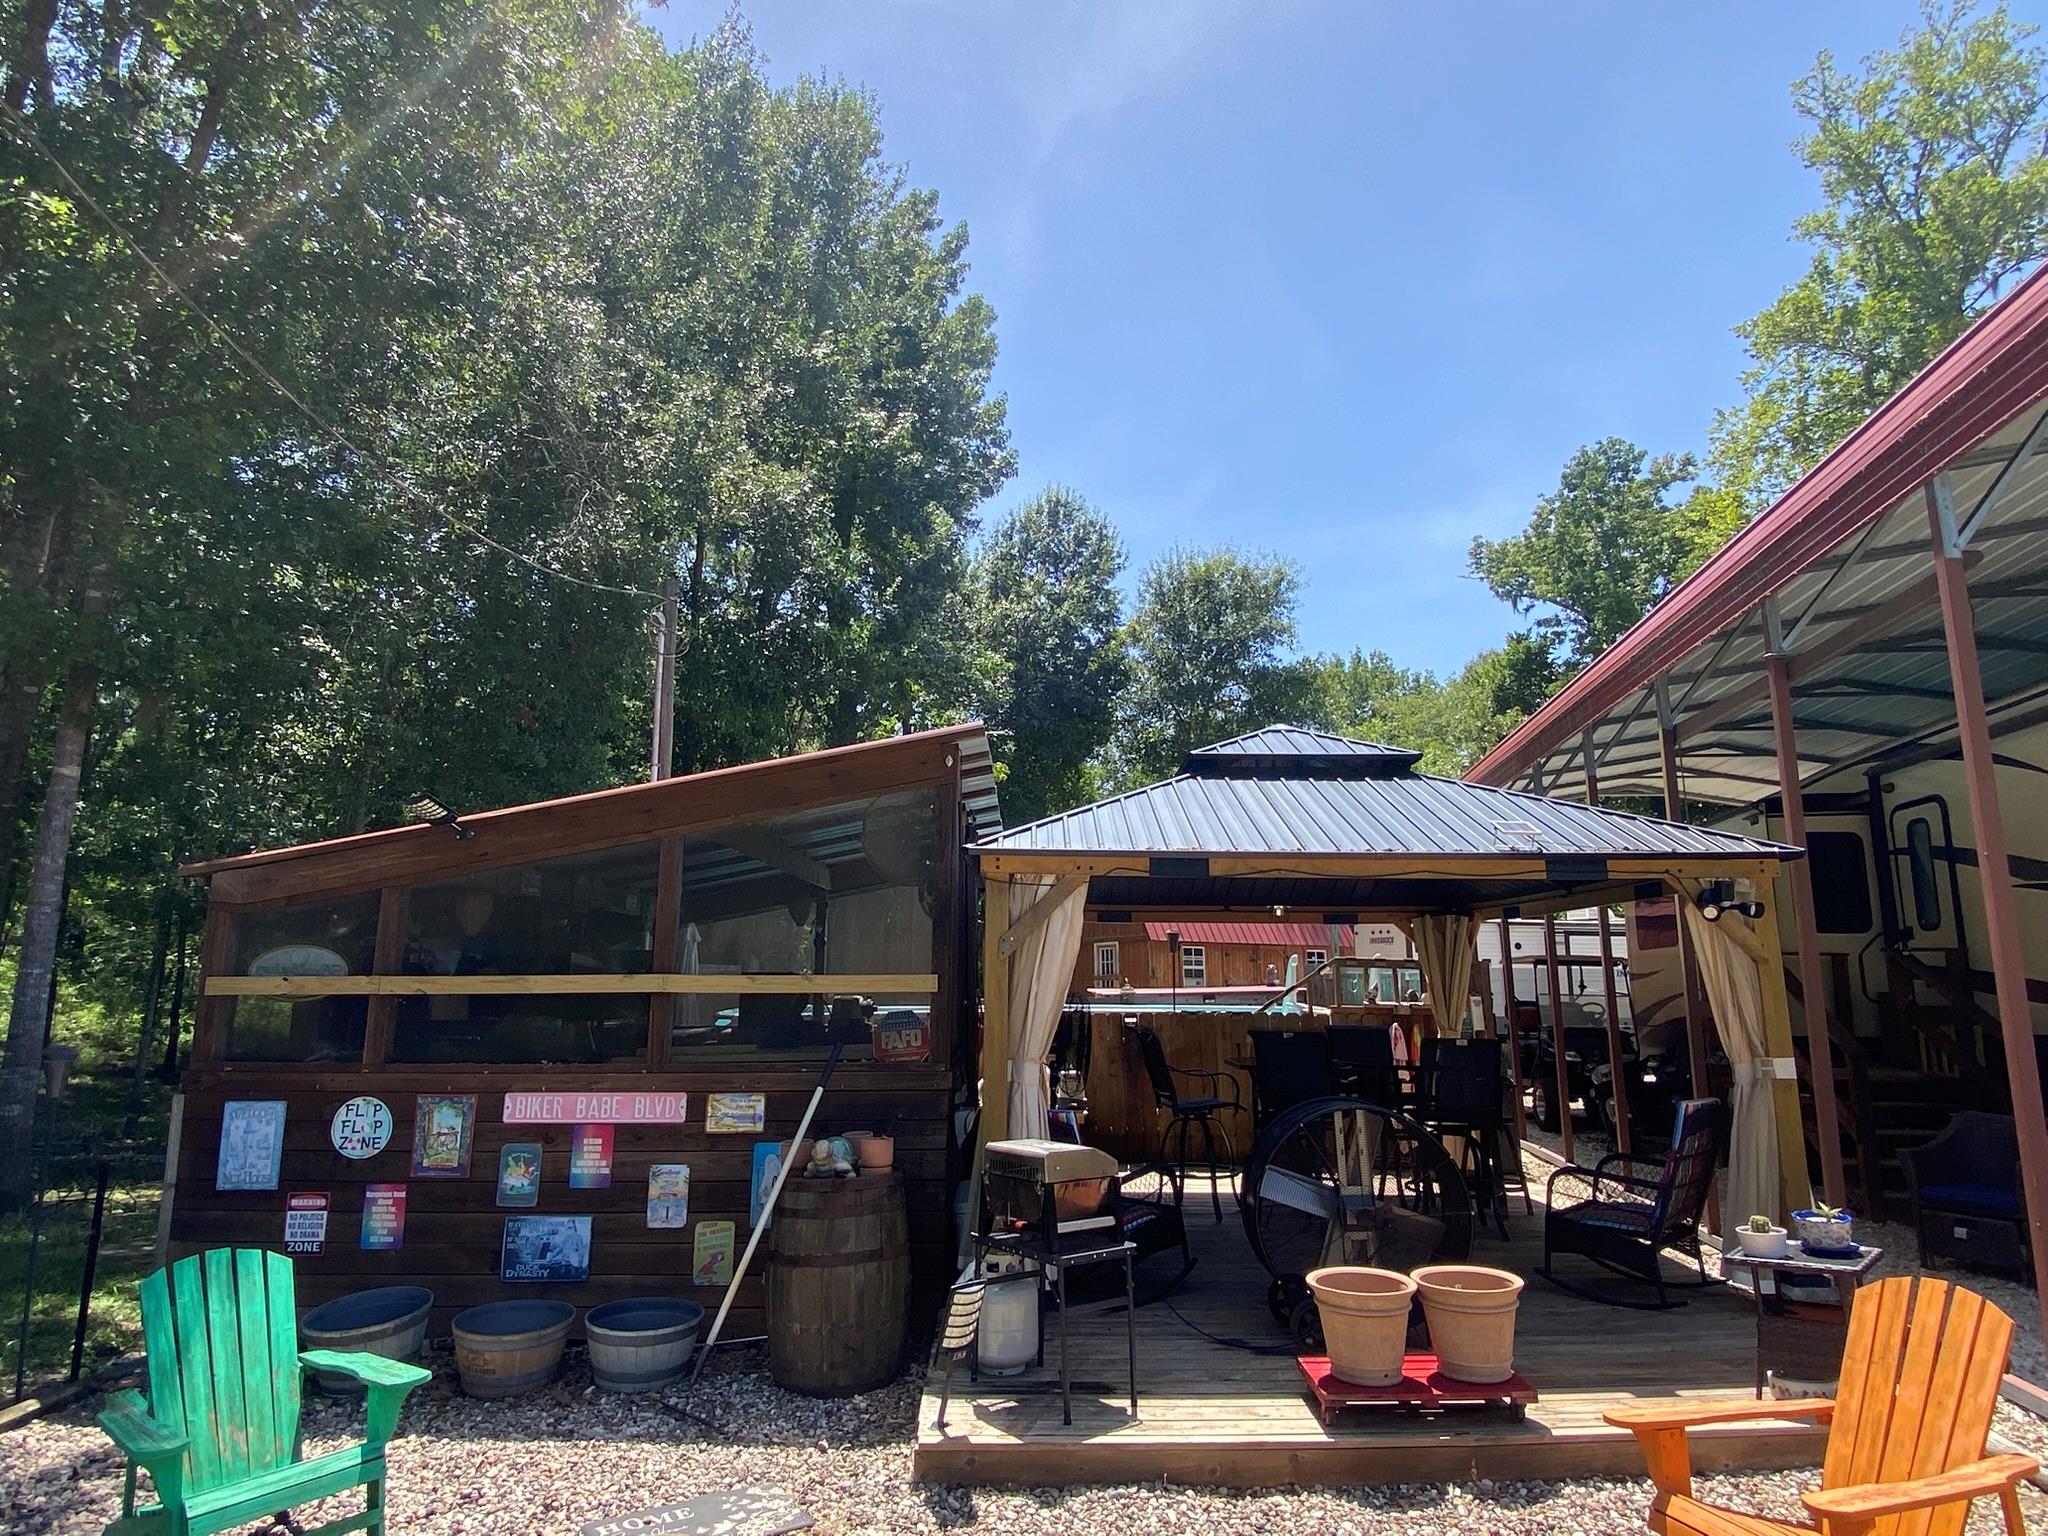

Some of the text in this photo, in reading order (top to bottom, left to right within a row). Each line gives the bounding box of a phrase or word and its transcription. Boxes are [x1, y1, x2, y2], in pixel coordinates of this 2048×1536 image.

[881, 1029, 922, 1049] FAFO
[515, 1096, 676, 1119] BIKER BABE BLVD
[289, 1212, 324, 1221] NO POLITICS
[288, 1221, 324, 1230] NO RELIGION
[289, 1230, 320, 1239] NO DRAMA
[287, 1241, 321, 1252] ZONE
[505, 1268, 550, 1277] DYNASTY
[594, 1507, 695, 1536] HOME
